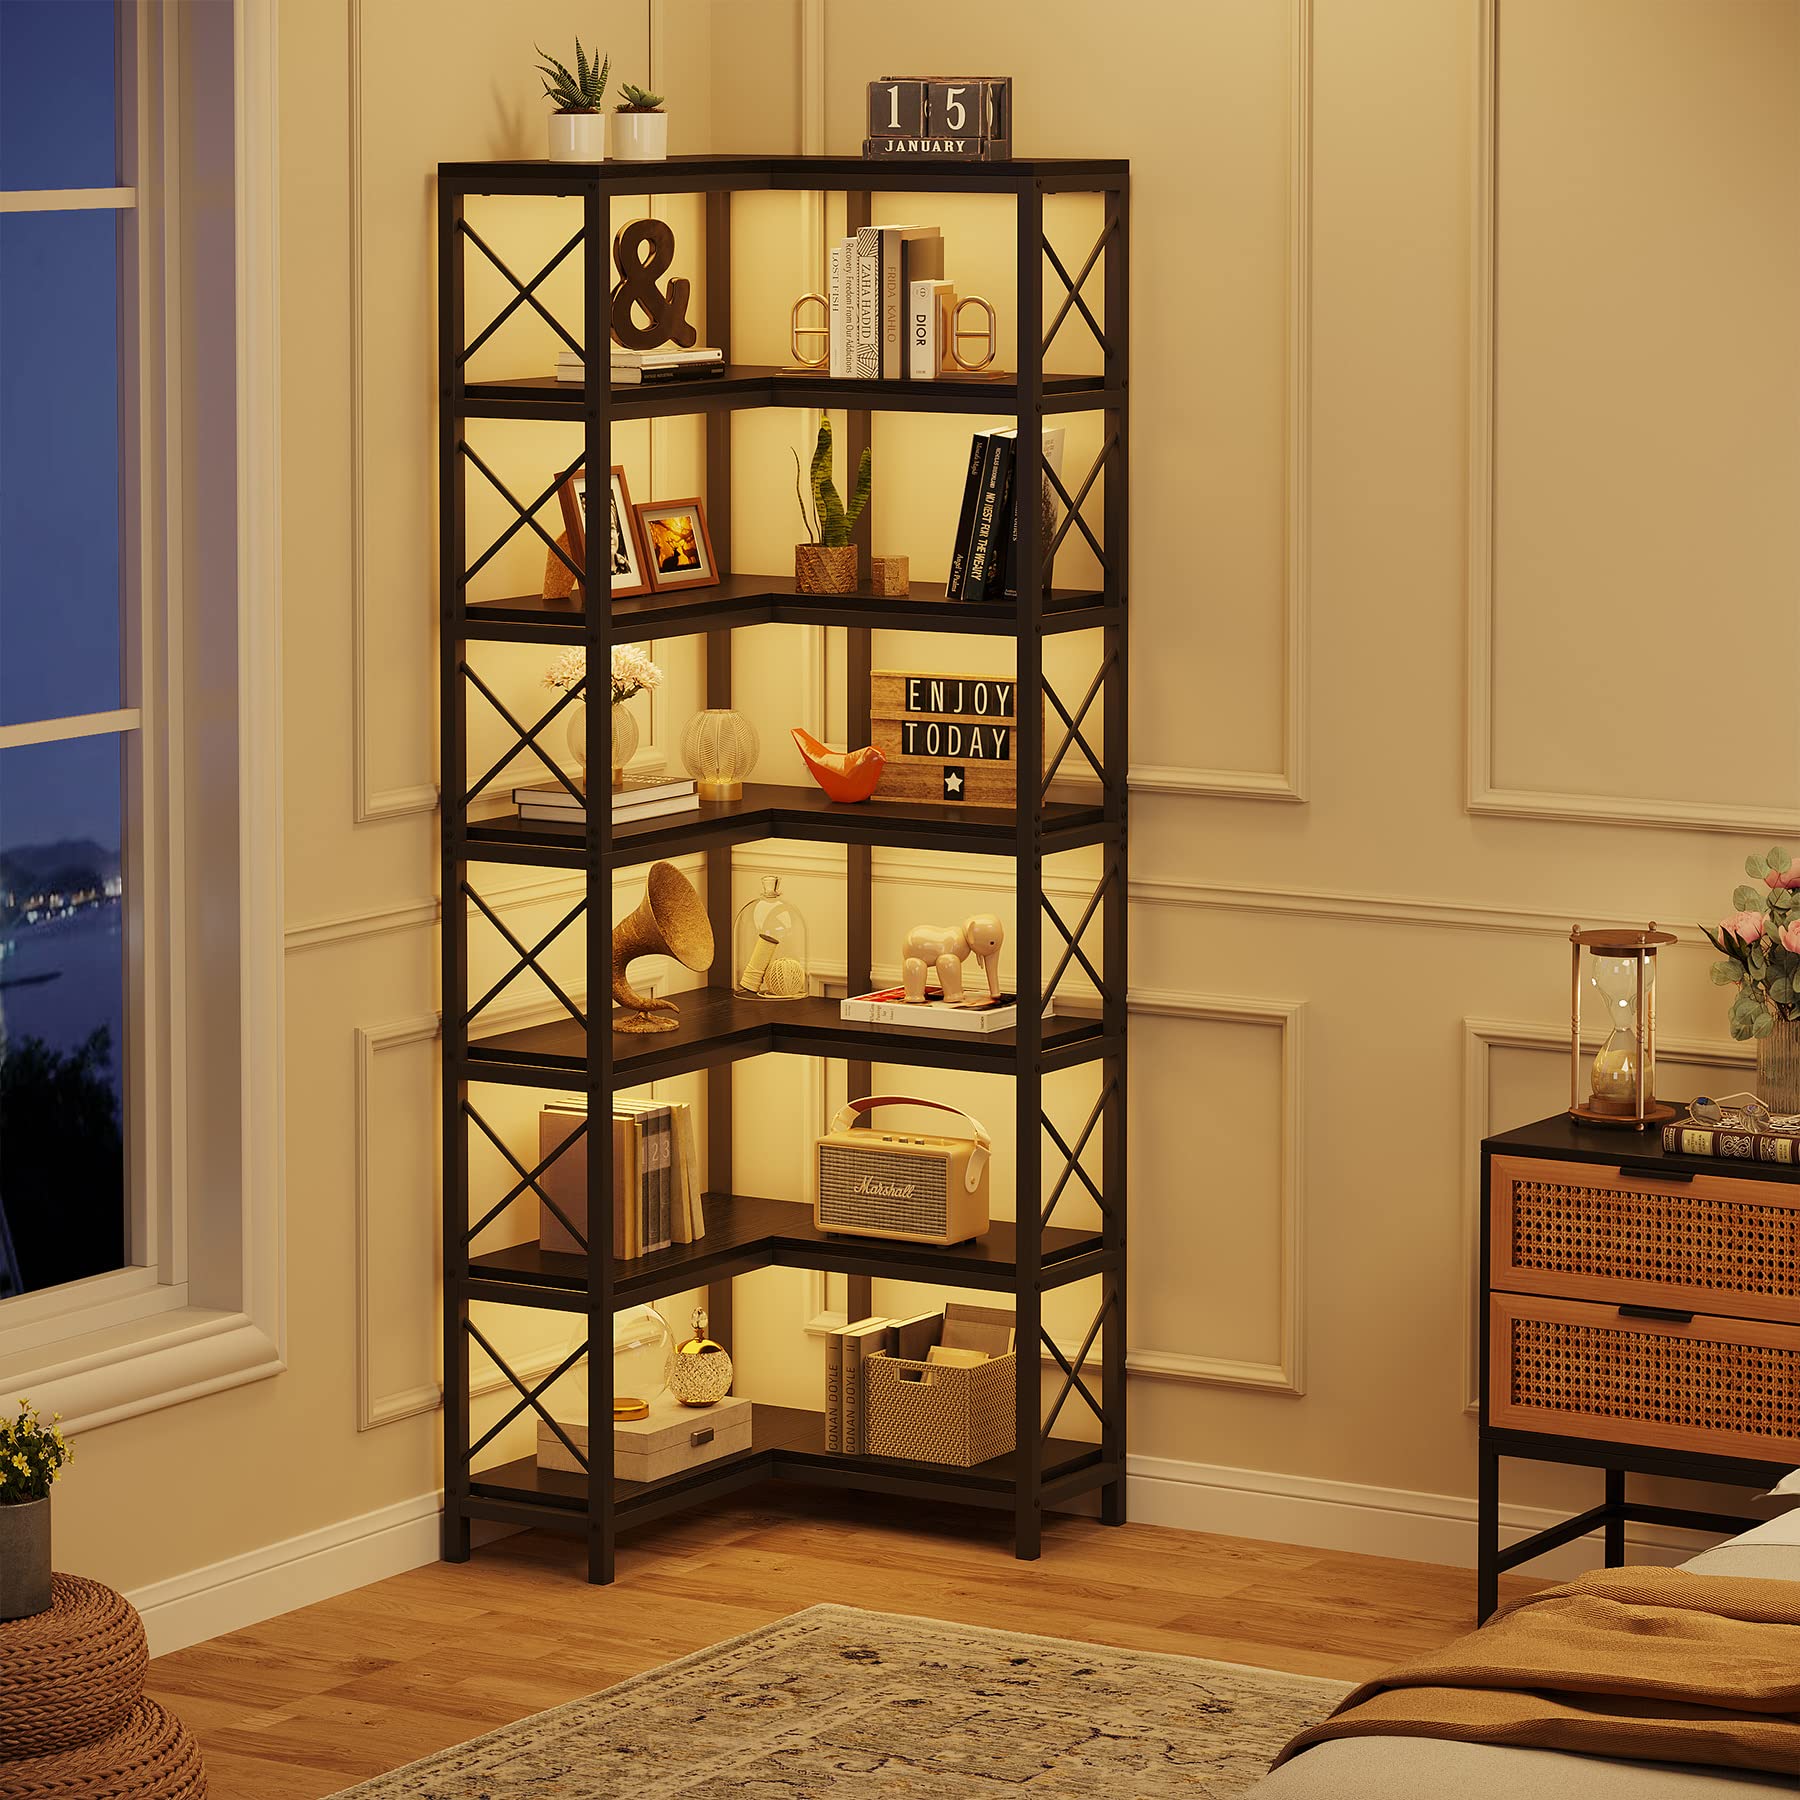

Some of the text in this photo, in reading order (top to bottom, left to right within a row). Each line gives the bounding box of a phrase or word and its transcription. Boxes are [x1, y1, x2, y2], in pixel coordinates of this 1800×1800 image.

[885, 140, 966, 153] JANUARY
[845, 276, 855, 305] Freedom
[862, 264, 871, 339] ZAHA HADID
[888, 267, 896, 343] FRIDA KAHLO
[845, 306, 854, 324] From
[845, 324, 854, 338] Our
[916, 315, 927, 346] DIOR
[845, 339, 855, 373] Addictions
[970, 492, 996, 581] NO REST FOR THE WEARY
[909, 679, 1010, 716] ENJOY
[905, 723, 1006, 759] TODAY
[853, 1175, 916, 1199] Marshall
[829, 1364, 838, 1401] DOYLE
[846, 1366, 855, 1405] DOYLE
[829, 1409, 838, 1451] CONAN
[846, 1411, 855, 1453] CONAN
